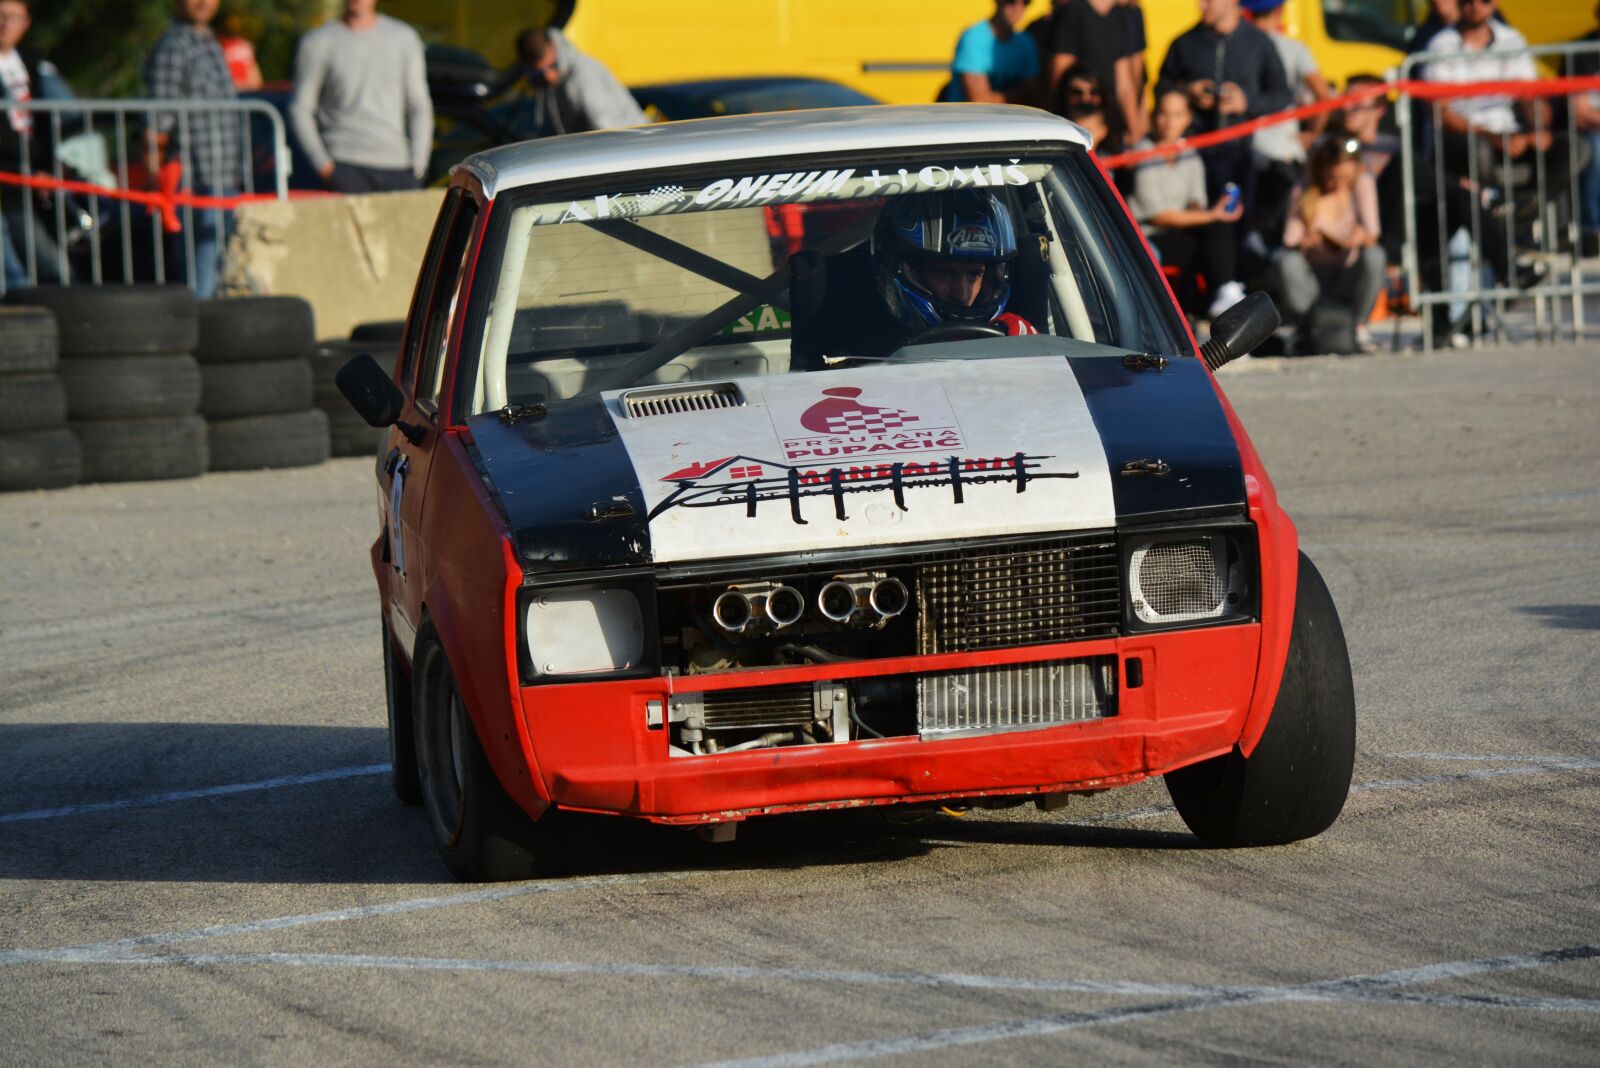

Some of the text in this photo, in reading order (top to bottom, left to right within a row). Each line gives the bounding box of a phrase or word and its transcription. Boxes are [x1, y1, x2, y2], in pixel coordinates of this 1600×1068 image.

[559, 192, 627, 224] AK
[694, 168, 856, 205] ONEUM
[784, 429, 959, 449] PRŠUTANA
[786, 436, 961, 460] PUPAČIĆ
